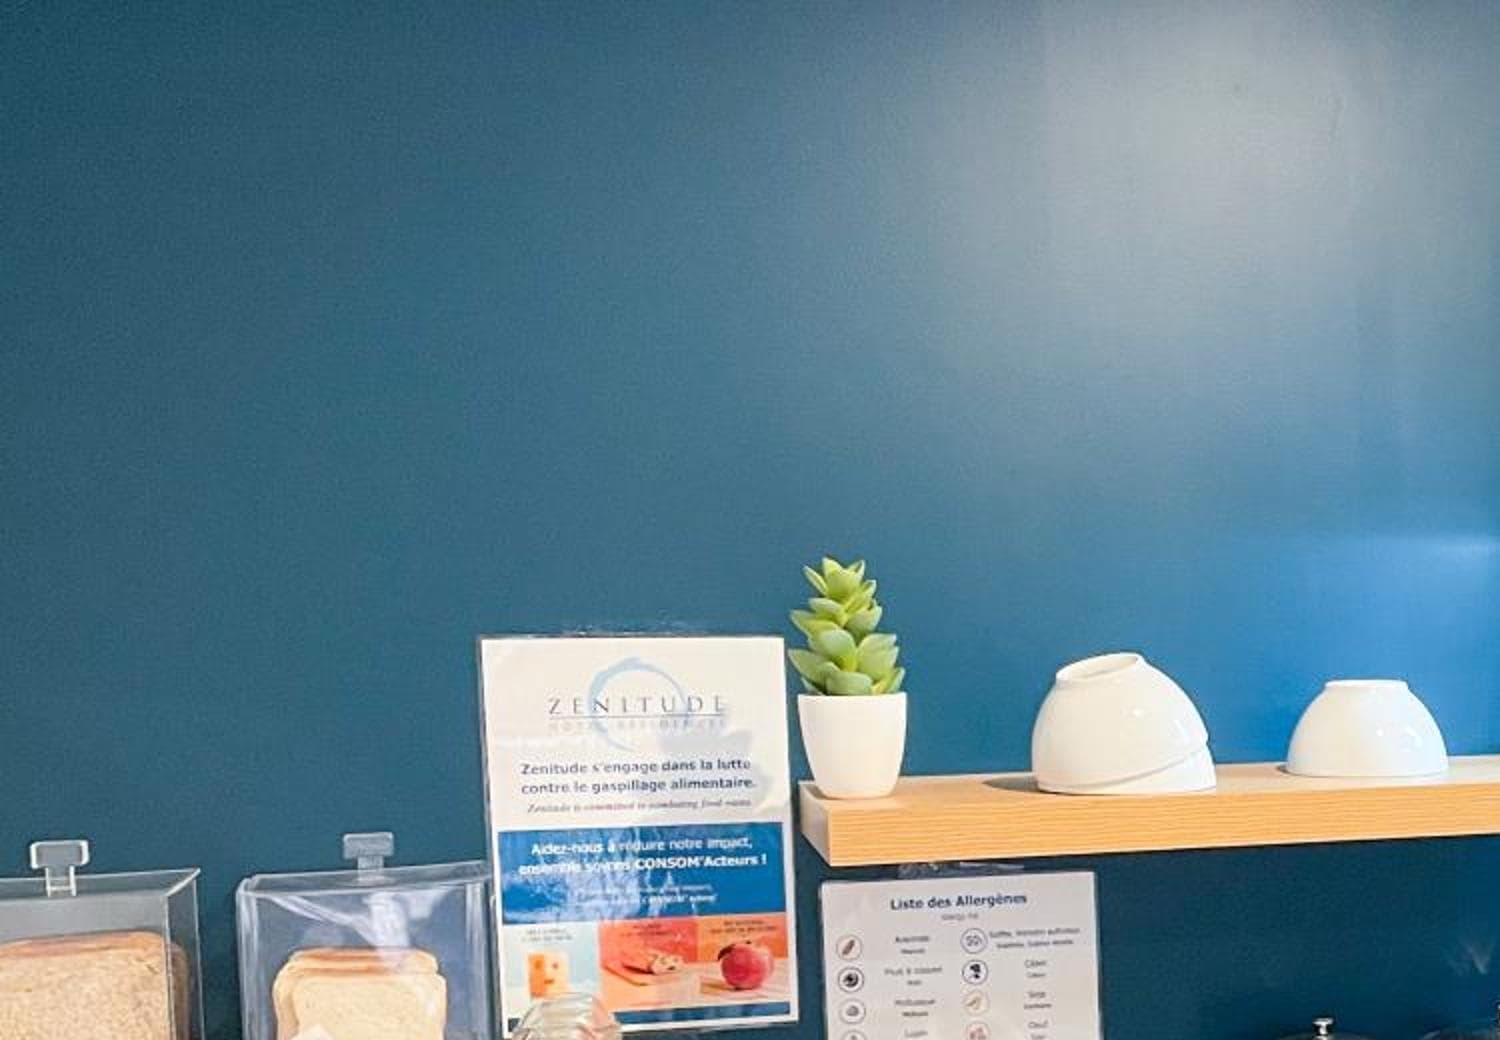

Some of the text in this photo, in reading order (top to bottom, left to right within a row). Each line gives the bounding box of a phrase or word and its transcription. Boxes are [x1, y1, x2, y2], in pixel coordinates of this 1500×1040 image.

[548, 694, 727, 716] ZENITUDE
[521, 758, 752, 777] Zenitude s'engage dans la lutte
[521, 776, 756, 797] contre le gaspillage alimentaire.
[531, 840, 604, 857] Aidez-nous
[669, 838, 703, 851] notre
[707, 836, 753, 851] impact,
[636, 854, 758, 870] CONSOM'Acteurs
[761, 854, 768, 866] !
[890, 897, 924, 911] Liste
[927, 896, 951, 909] des
